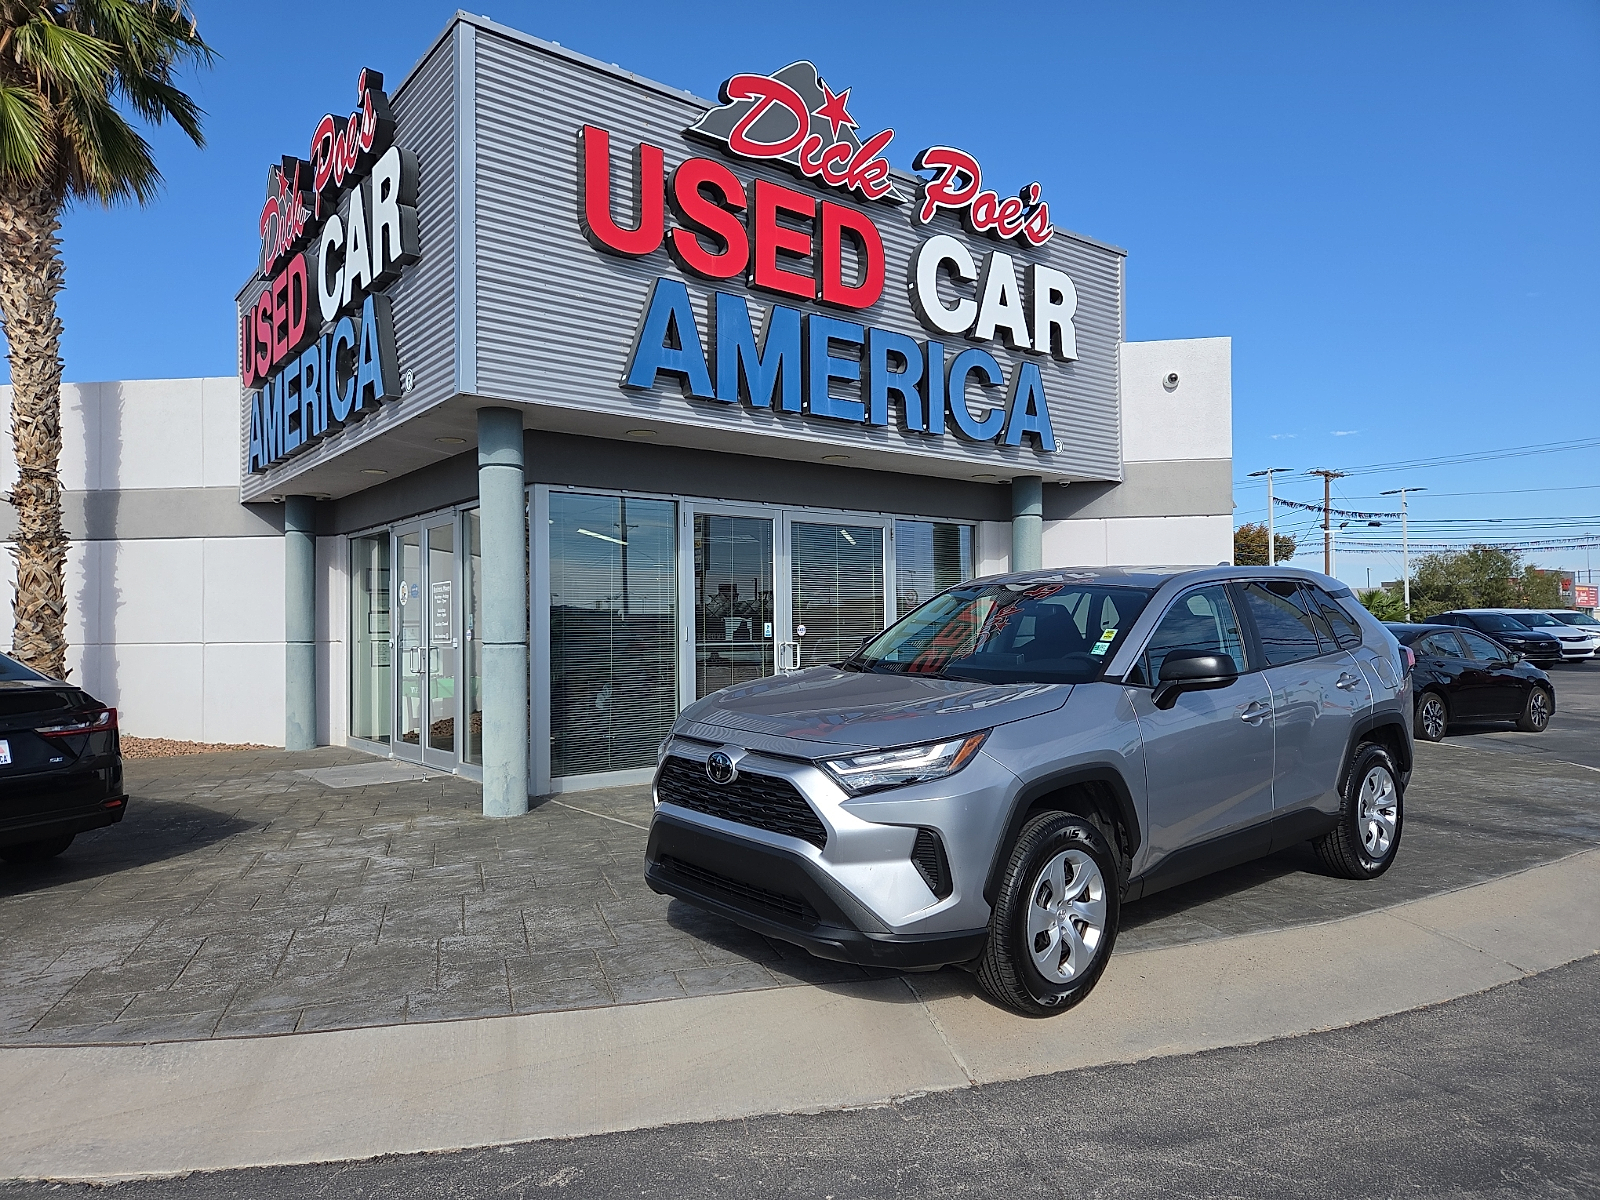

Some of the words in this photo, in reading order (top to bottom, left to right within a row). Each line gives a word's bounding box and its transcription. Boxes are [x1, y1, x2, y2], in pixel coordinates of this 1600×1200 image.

[260, 160, 308, 277] Dick
[310, 67, 378, 220] Poe's
[584, 124, 886, 309] USED
[915, 234, 1079, 362] CAR
[727, 73, 895, 200] Dick
[919, 145, 1054, 246] Poe's
[242, 252, 308, 389] USED
[318, 145, 401, 322] CAR
[248, 294, 384, 475] AMERICA
[624, 277, 1056, 453] AMERICA
